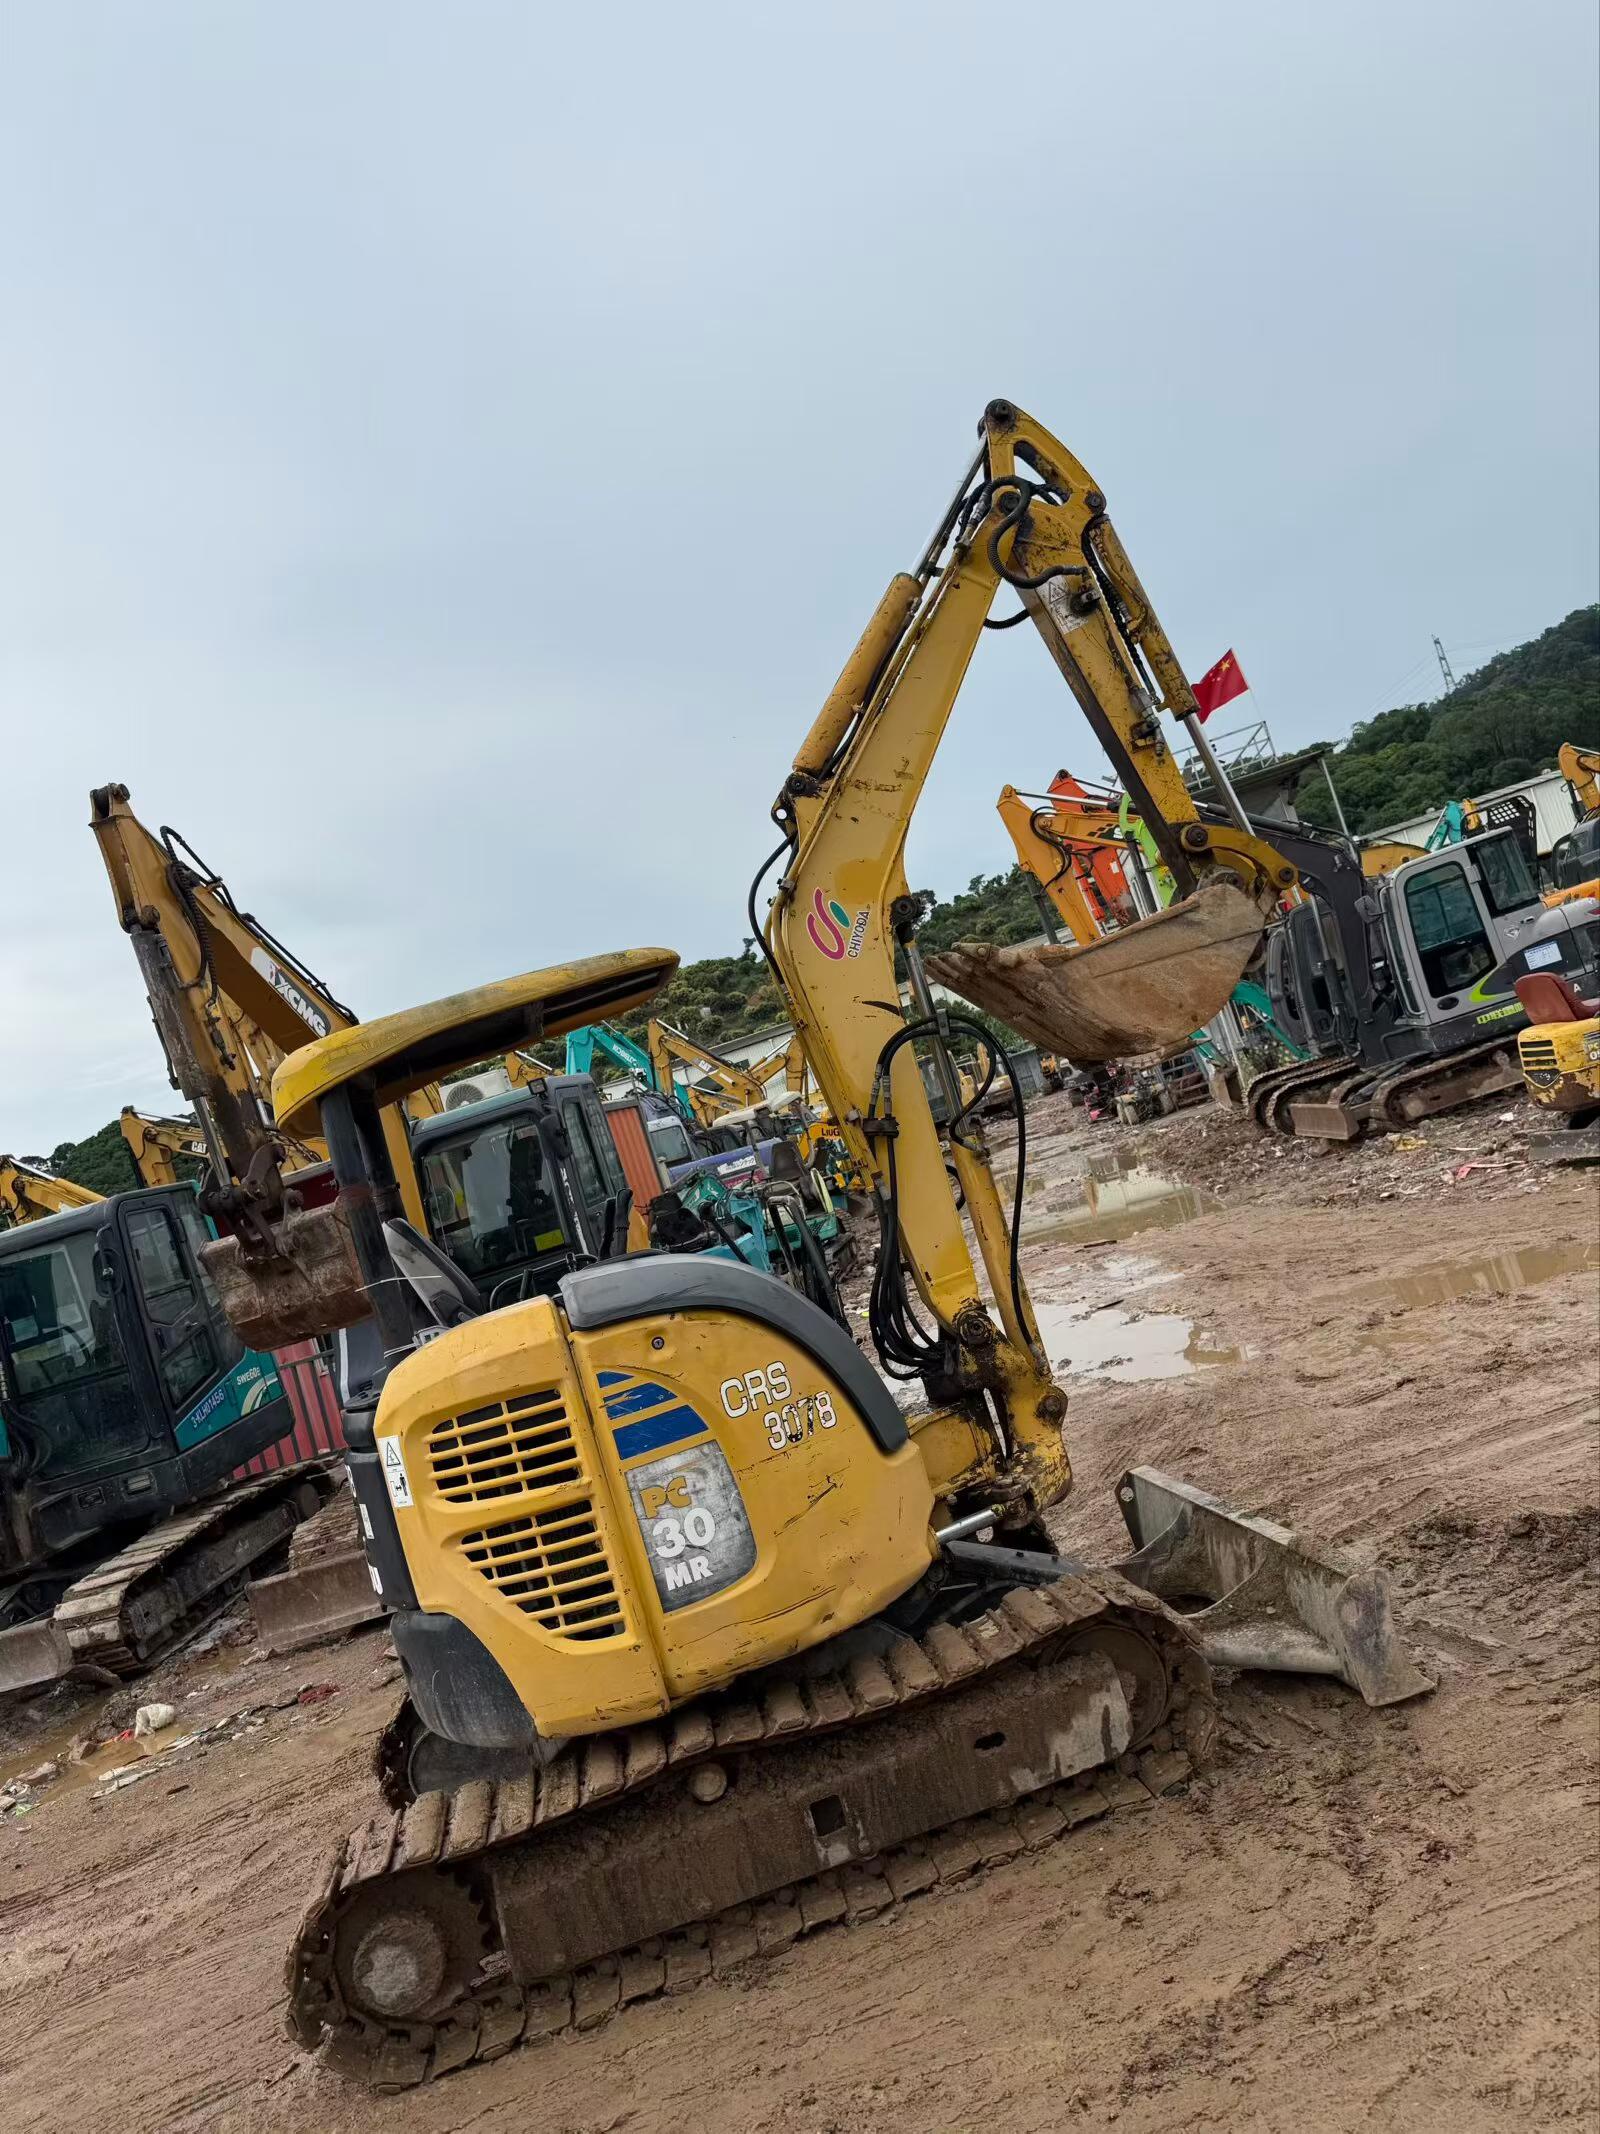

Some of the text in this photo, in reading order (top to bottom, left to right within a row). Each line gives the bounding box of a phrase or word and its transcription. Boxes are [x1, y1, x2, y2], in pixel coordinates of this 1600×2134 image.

[847, 911, 870, 958] CHIYODA
[275, 973, 327, 1037] XCMG
[191, 1141, 207, 1154] CAT
[720, 1360, 792, 1419] CRS
[763, 1390, 838, 1450] 3078
[640, 1476, 692, 1518] PC
[652, 1507, 716, 1558] 30
[664, 1555, 714, 1591] MR
